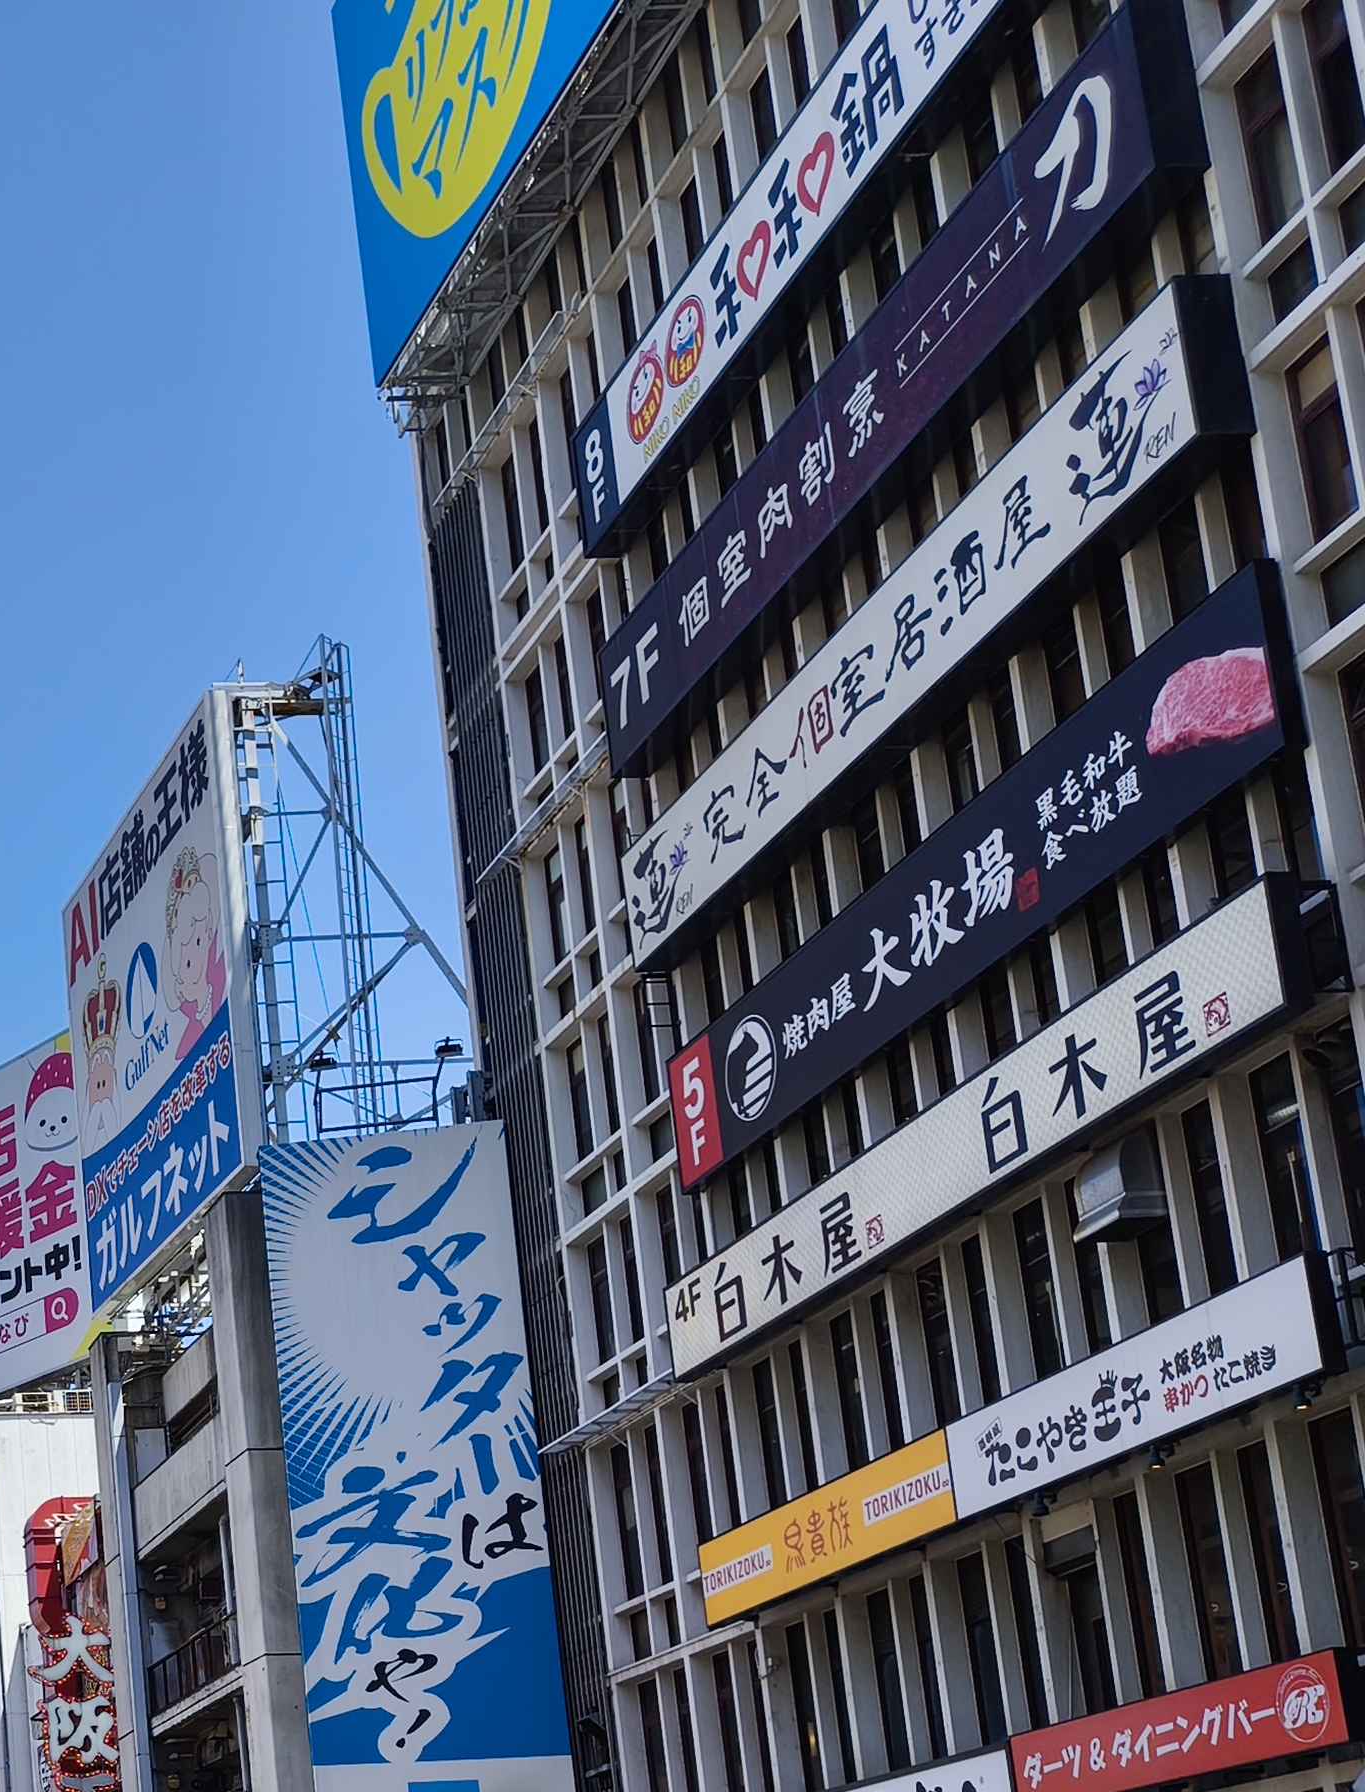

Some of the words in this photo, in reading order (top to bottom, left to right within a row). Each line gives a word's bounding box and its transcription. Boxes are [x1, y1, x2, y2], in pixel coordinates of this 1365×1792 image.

[897, 216, 1027, 380] KATANA
[585, 428, 608, 524] 8F
[677, 369, 885, 650] 個室肉割烹
[610, 622, 661, 730] 7F
[703, 474, 1052, 864] 完全個室居酒屋
[1034, 730, 1134, 827] 黒毛和牛
[1040, 772, 1141, 870] 食べ放題
[69, 717, 210, 991] AI店舗の王様
[862, 827, 1017, 1013] 大牧場
[782, 973, 855, 1060] 焼肉屋
[981, 970, 1196, 1175] 白木屋
[86, 1031, 230, 1222] DXでチェーン店を改革する
[680, 1055, 706, 1167] 5F
[95, 1100, 230, 1294] ガルフネット
[674, 1277, 702, 1324] 4F
[713, 1191, 863, 1344] 白木屋
[1159, 1335, 1224, 1385] 大阪名物
[1163, 1374, 1209, 1413] 串かつ
[1214, 1344, 1276, 1391] たこ焼き
[985, 1371, 1151, 1486] たこやき王子
[864, 1469, 941, 1521] TORIKIZOKU
[703, 1553, 766, 1594] TORIKIZOKU
